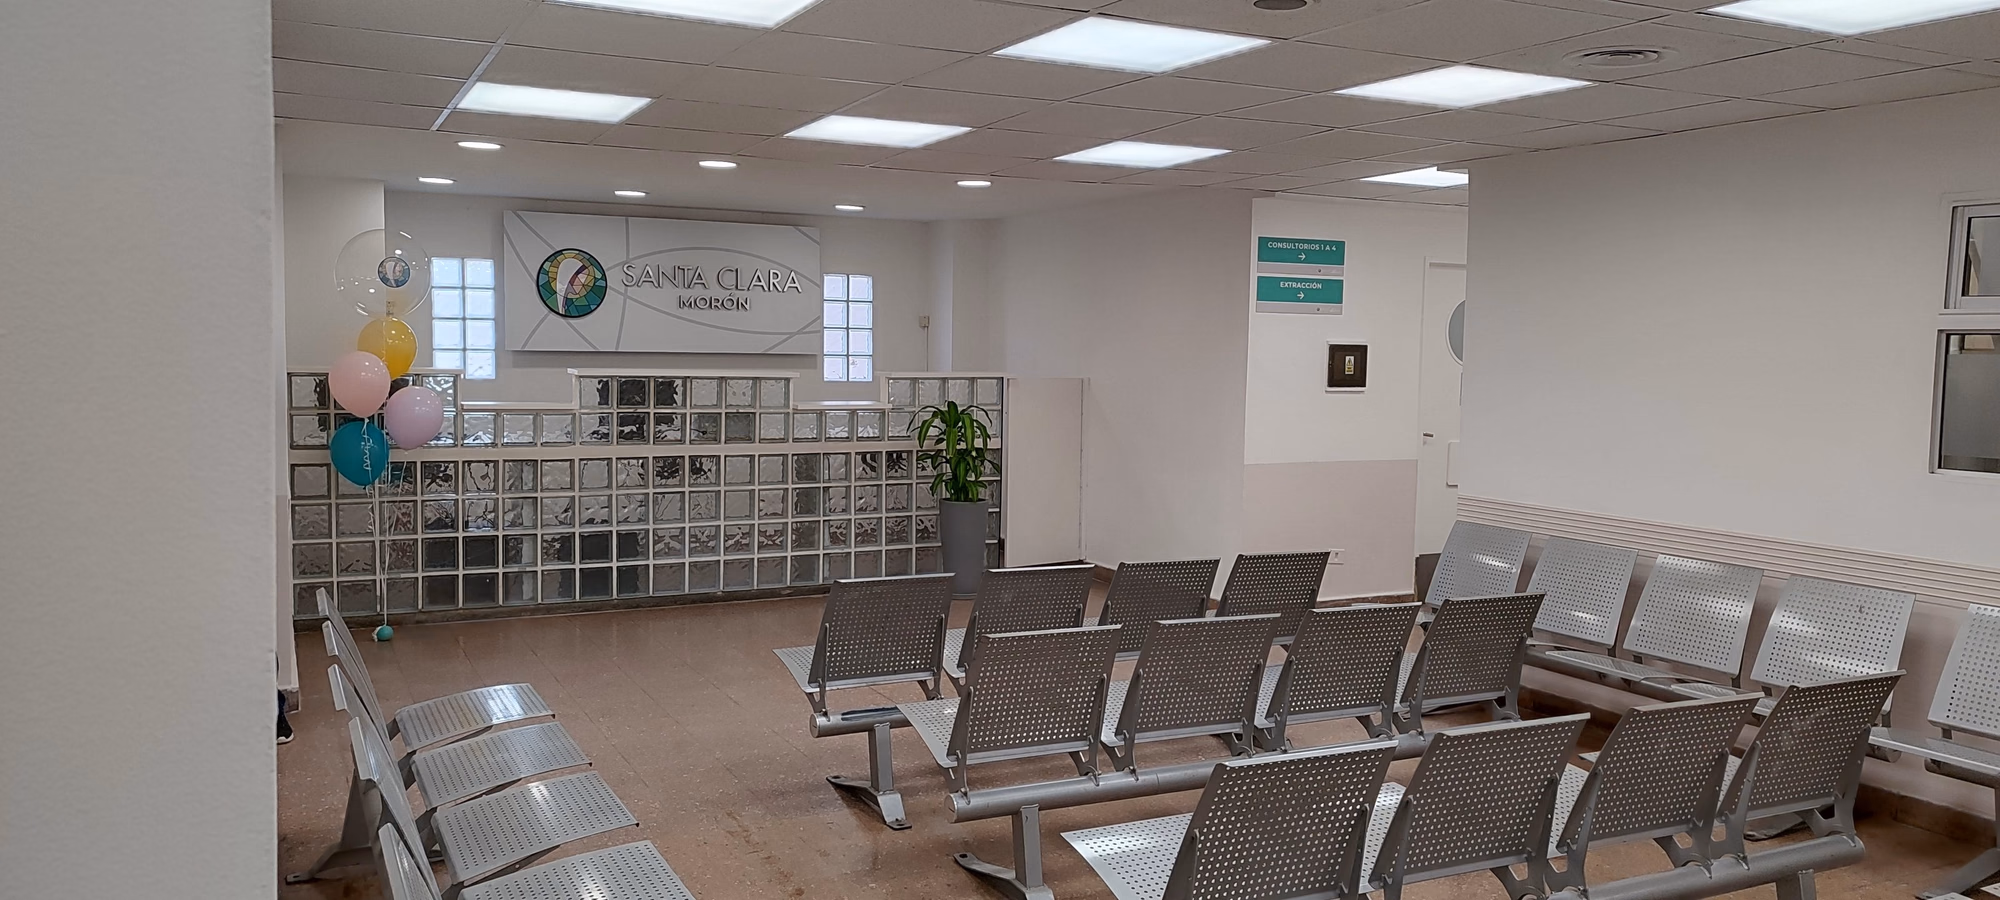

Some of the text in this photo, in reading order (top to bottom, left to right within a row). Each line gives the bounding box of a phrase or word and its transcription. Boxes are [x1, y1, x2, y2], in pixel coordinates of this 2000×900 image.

[1267, 242, 1320, 250] CONSULTORIOS
[621, 263, 803, 294] SANTA CLARA
[678, 292, 751, 311] MORÓN
